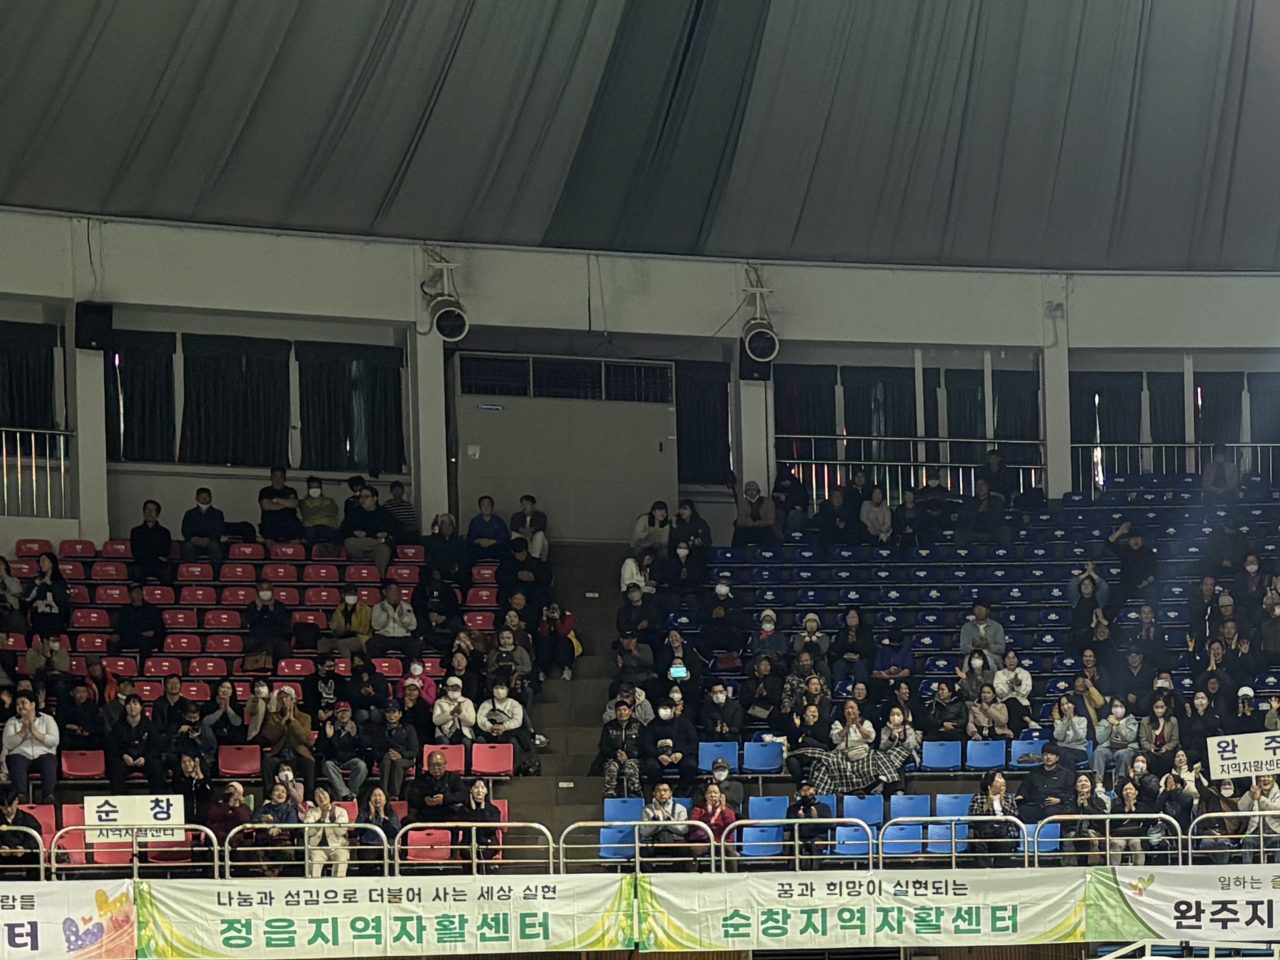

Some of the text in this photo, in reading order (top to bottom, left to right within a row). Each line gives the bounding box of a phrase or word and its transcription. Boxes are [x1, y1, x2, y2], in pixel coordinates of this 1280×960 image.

[217, 884, 557, 907] 나눔과 섬김으로 더불어 사는 세상 실현
[777, 879, 968, 898] 꿈과 희망이 실현되는
[1218, 876, 1263, 890] 일하는
[220, 912, 550, 948] 정읍지역자활센터
[721, 904, 1018, 939] 순창지역자활센터
[4, 921, 39, 950] 터
